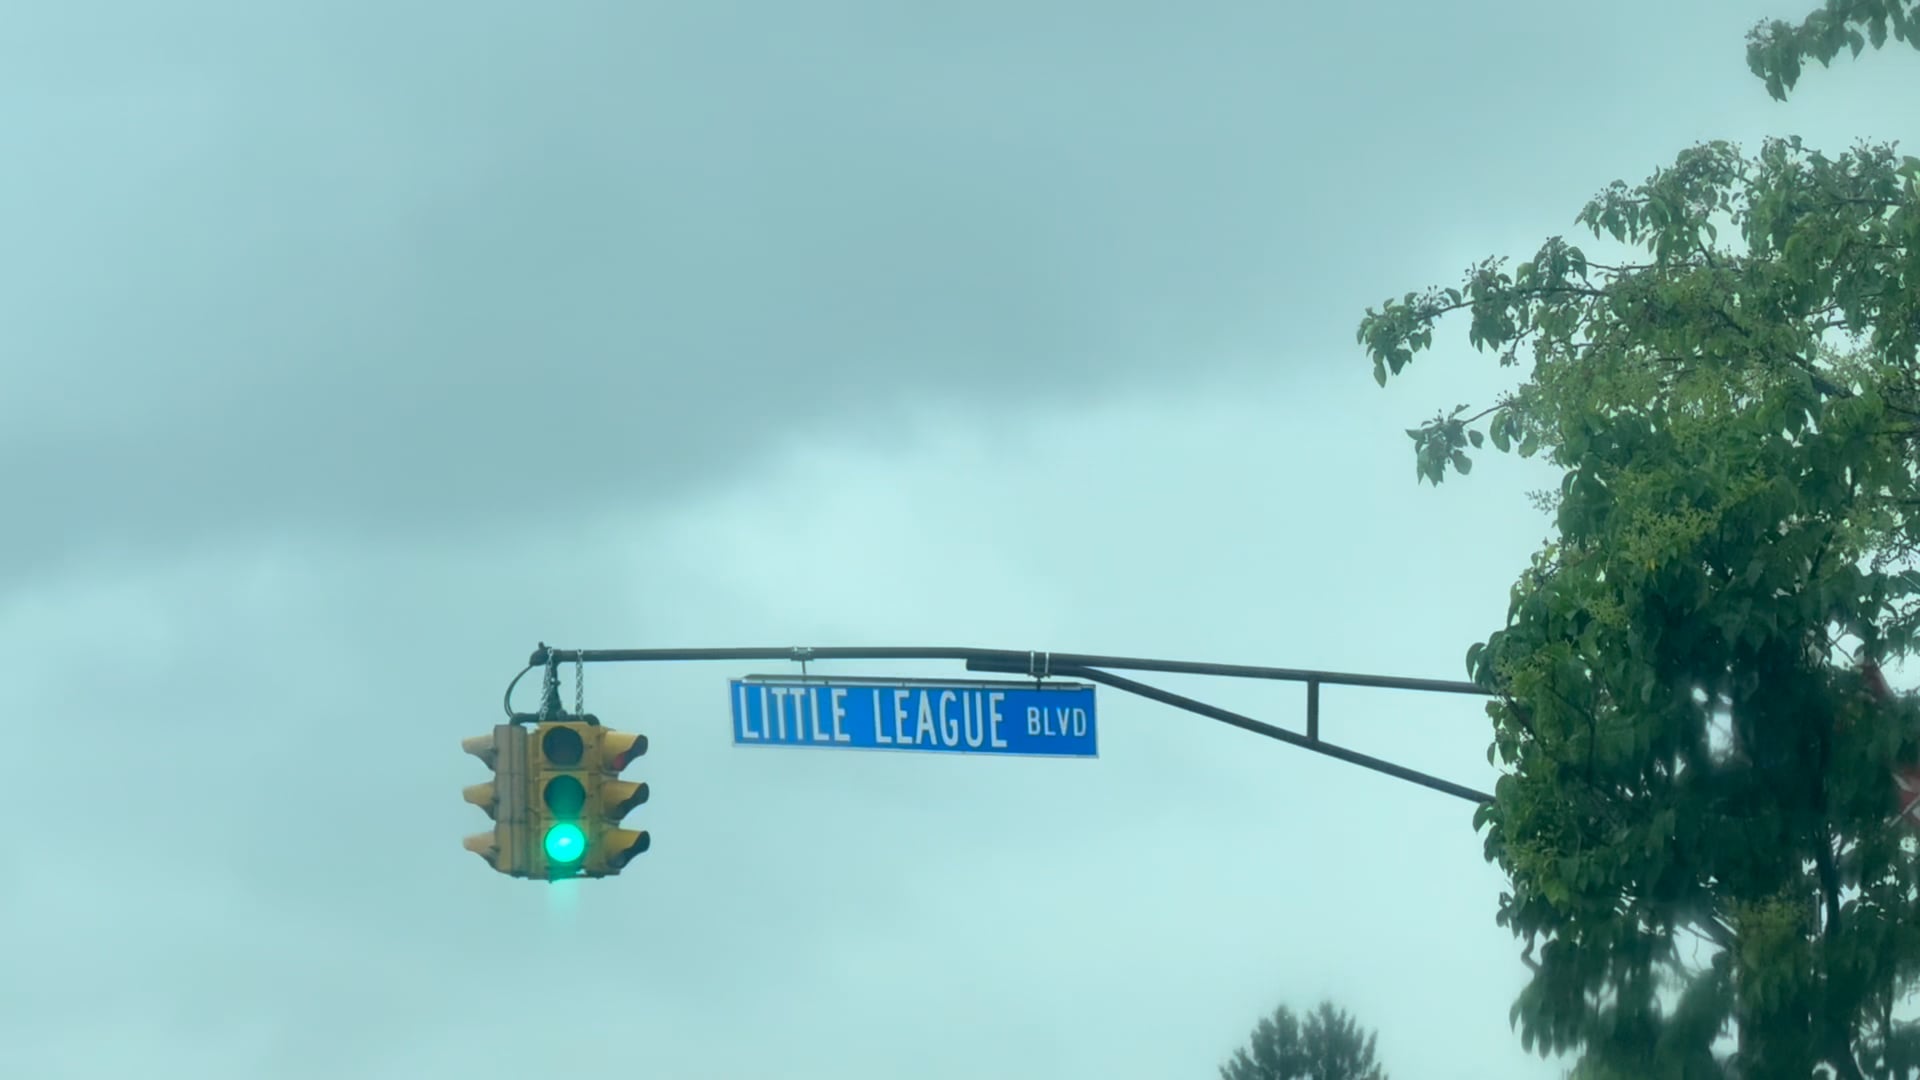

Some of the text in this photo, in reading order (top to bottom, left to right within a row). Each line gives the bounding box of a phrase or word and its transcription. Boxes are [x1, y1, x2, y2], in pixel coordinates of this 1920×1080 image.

[739, 686, 1087, 748] LITTLE LEAGUE BLVD
